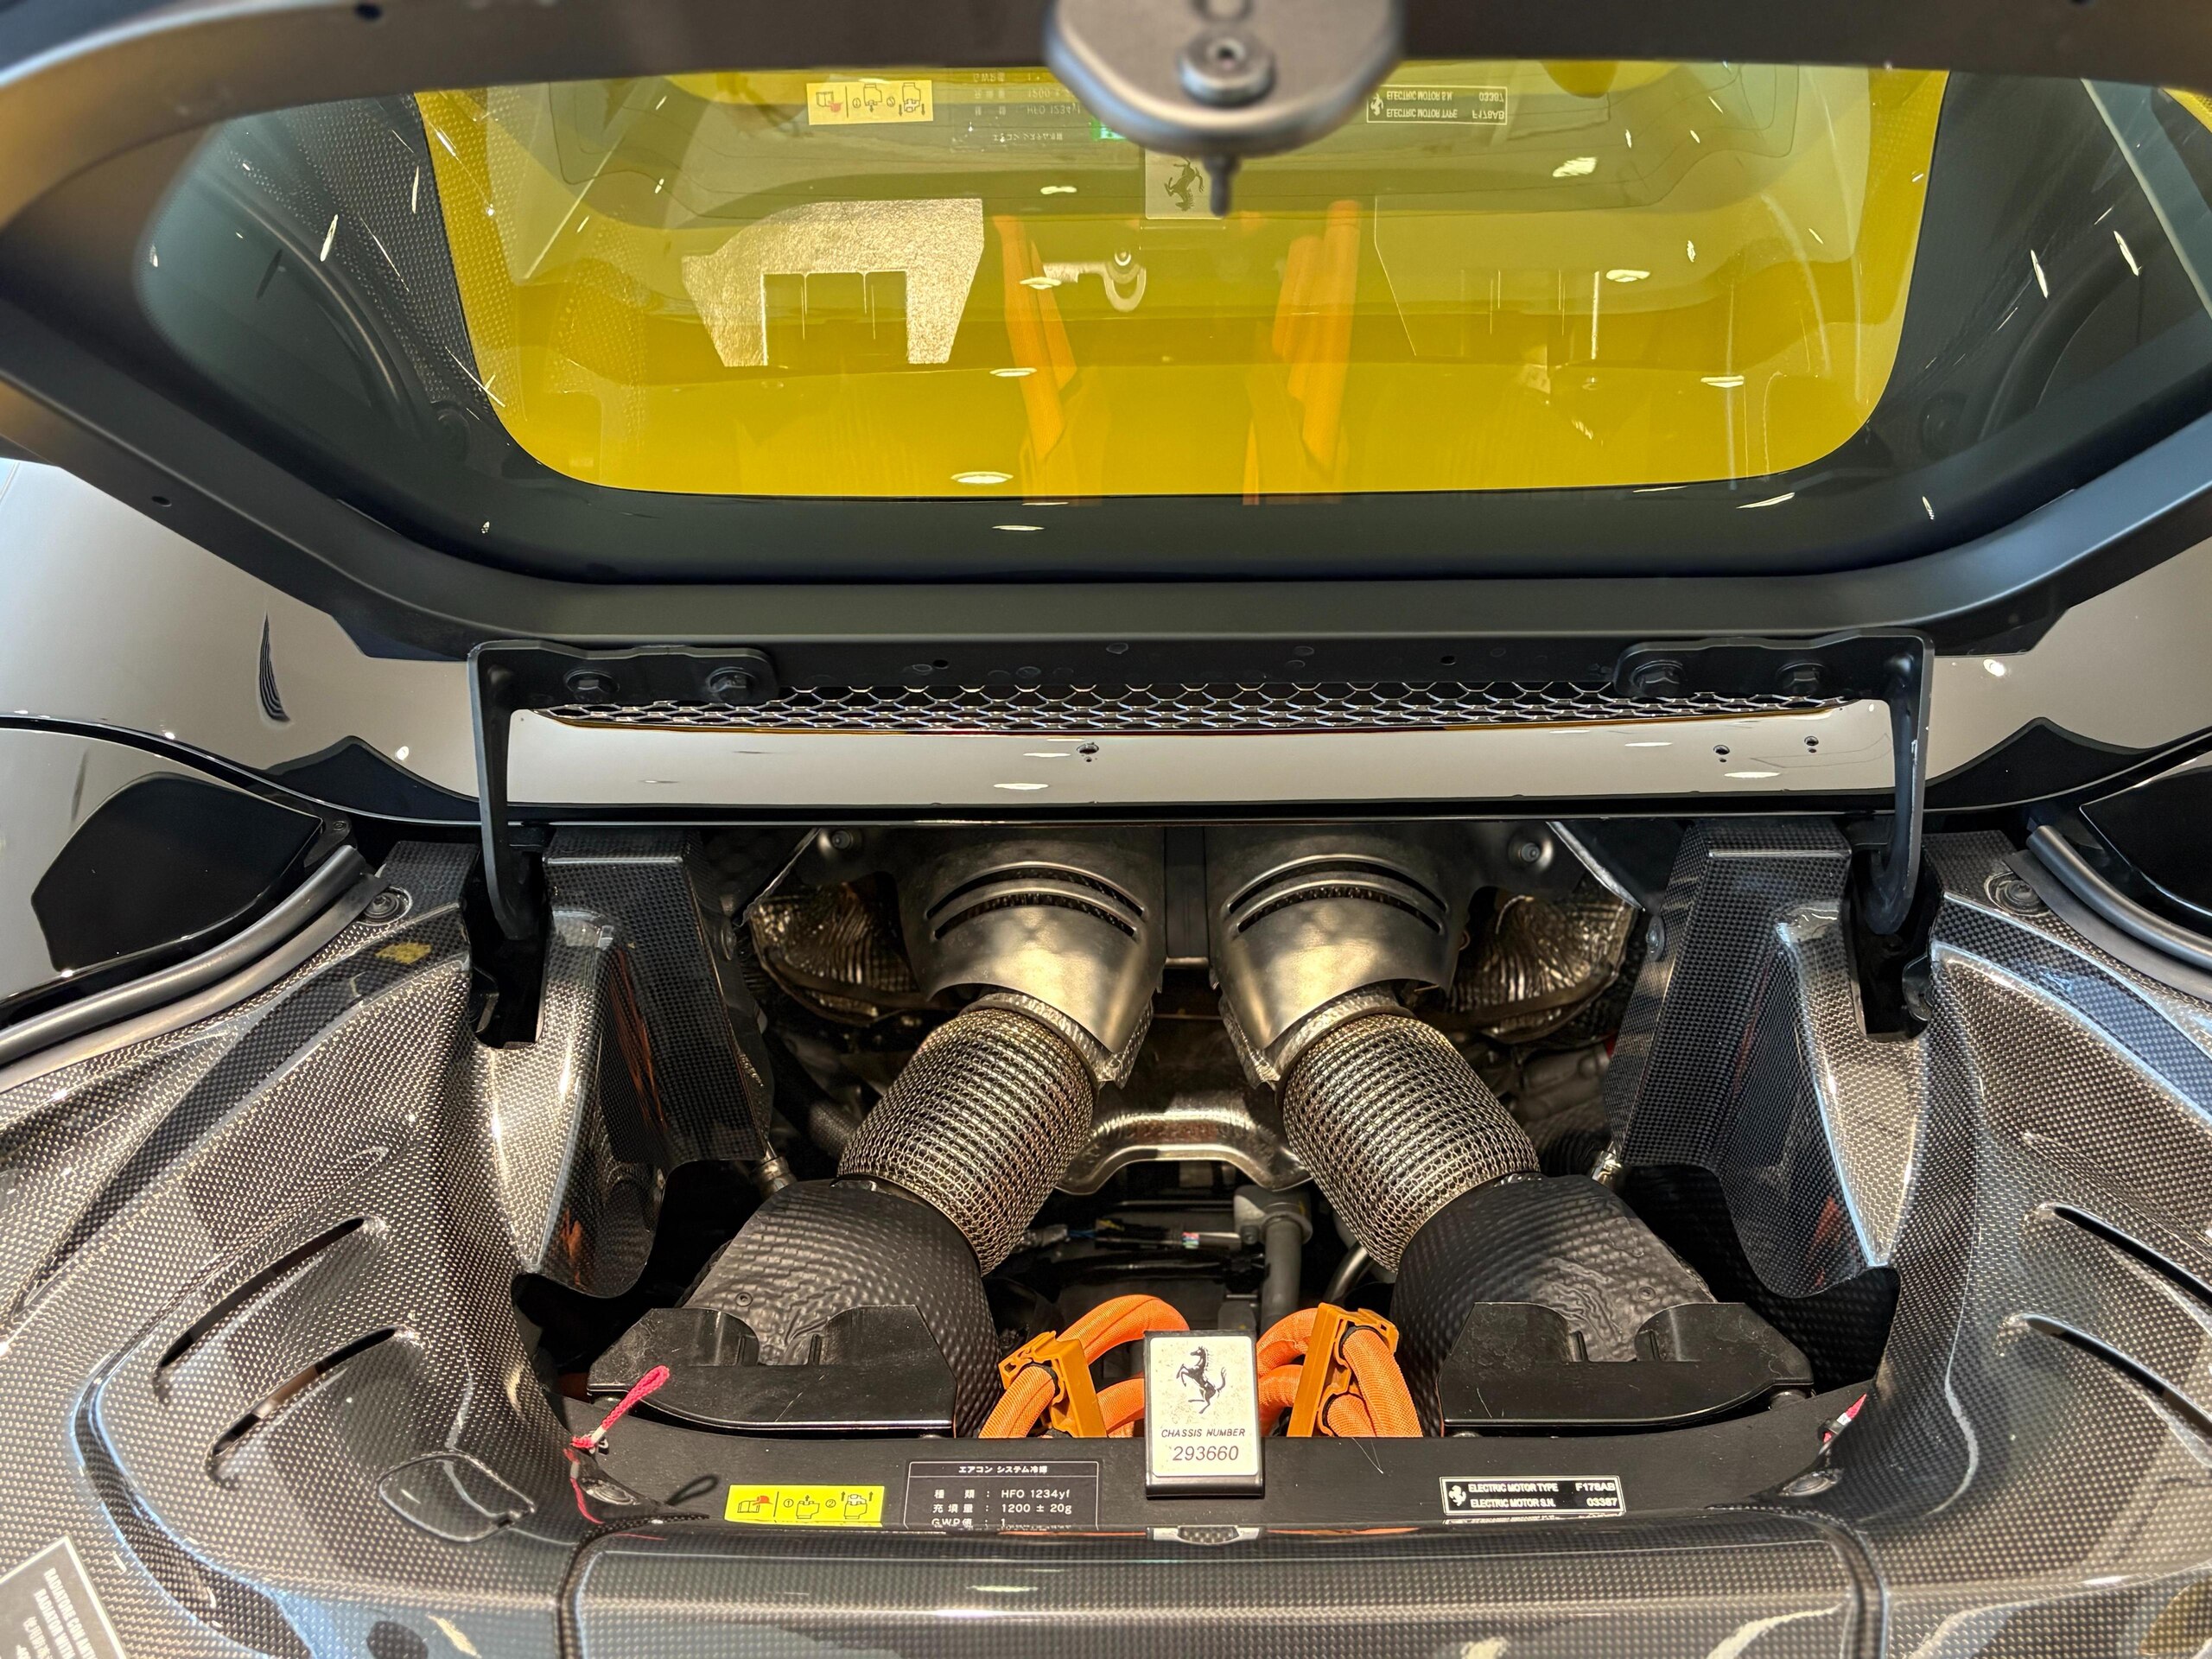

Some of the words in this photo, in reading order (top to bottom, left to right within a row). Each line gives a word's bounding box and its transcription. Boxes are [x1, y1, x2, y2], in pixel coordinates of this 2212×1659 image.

[1160, 1428, 1203, 1438] CHASSIS
[1205, 1427, 1246, 1437] NUMBER
[1172, 1445, 1239, 1461] 293660
[1468, 1484, 1507, 1492] ELECTRIC
[1507, 1484, 1537, 1492] MOTOR
[1536, 1483, 1559, 1492] TYPE
[1575, 1482, 1616, 1492] F178AB
[1001, 1489, 1025, 1499] HFO
[1030, 1489, 1071, 1501] 1234yf
[1001, 1503, 1031, 1513] 1200
[1049, 1503, 1072, 1515] 20g
[1471, 1499, 1509, 1508] ELECTRIC
[1510, 1498, 1540, 1507] MOTOR
[44, 1567, 76, 1621] RADIATORE
[67, 1617, 86, 1641] CON
[33, 1588, 64, 1638] RADIATOR
